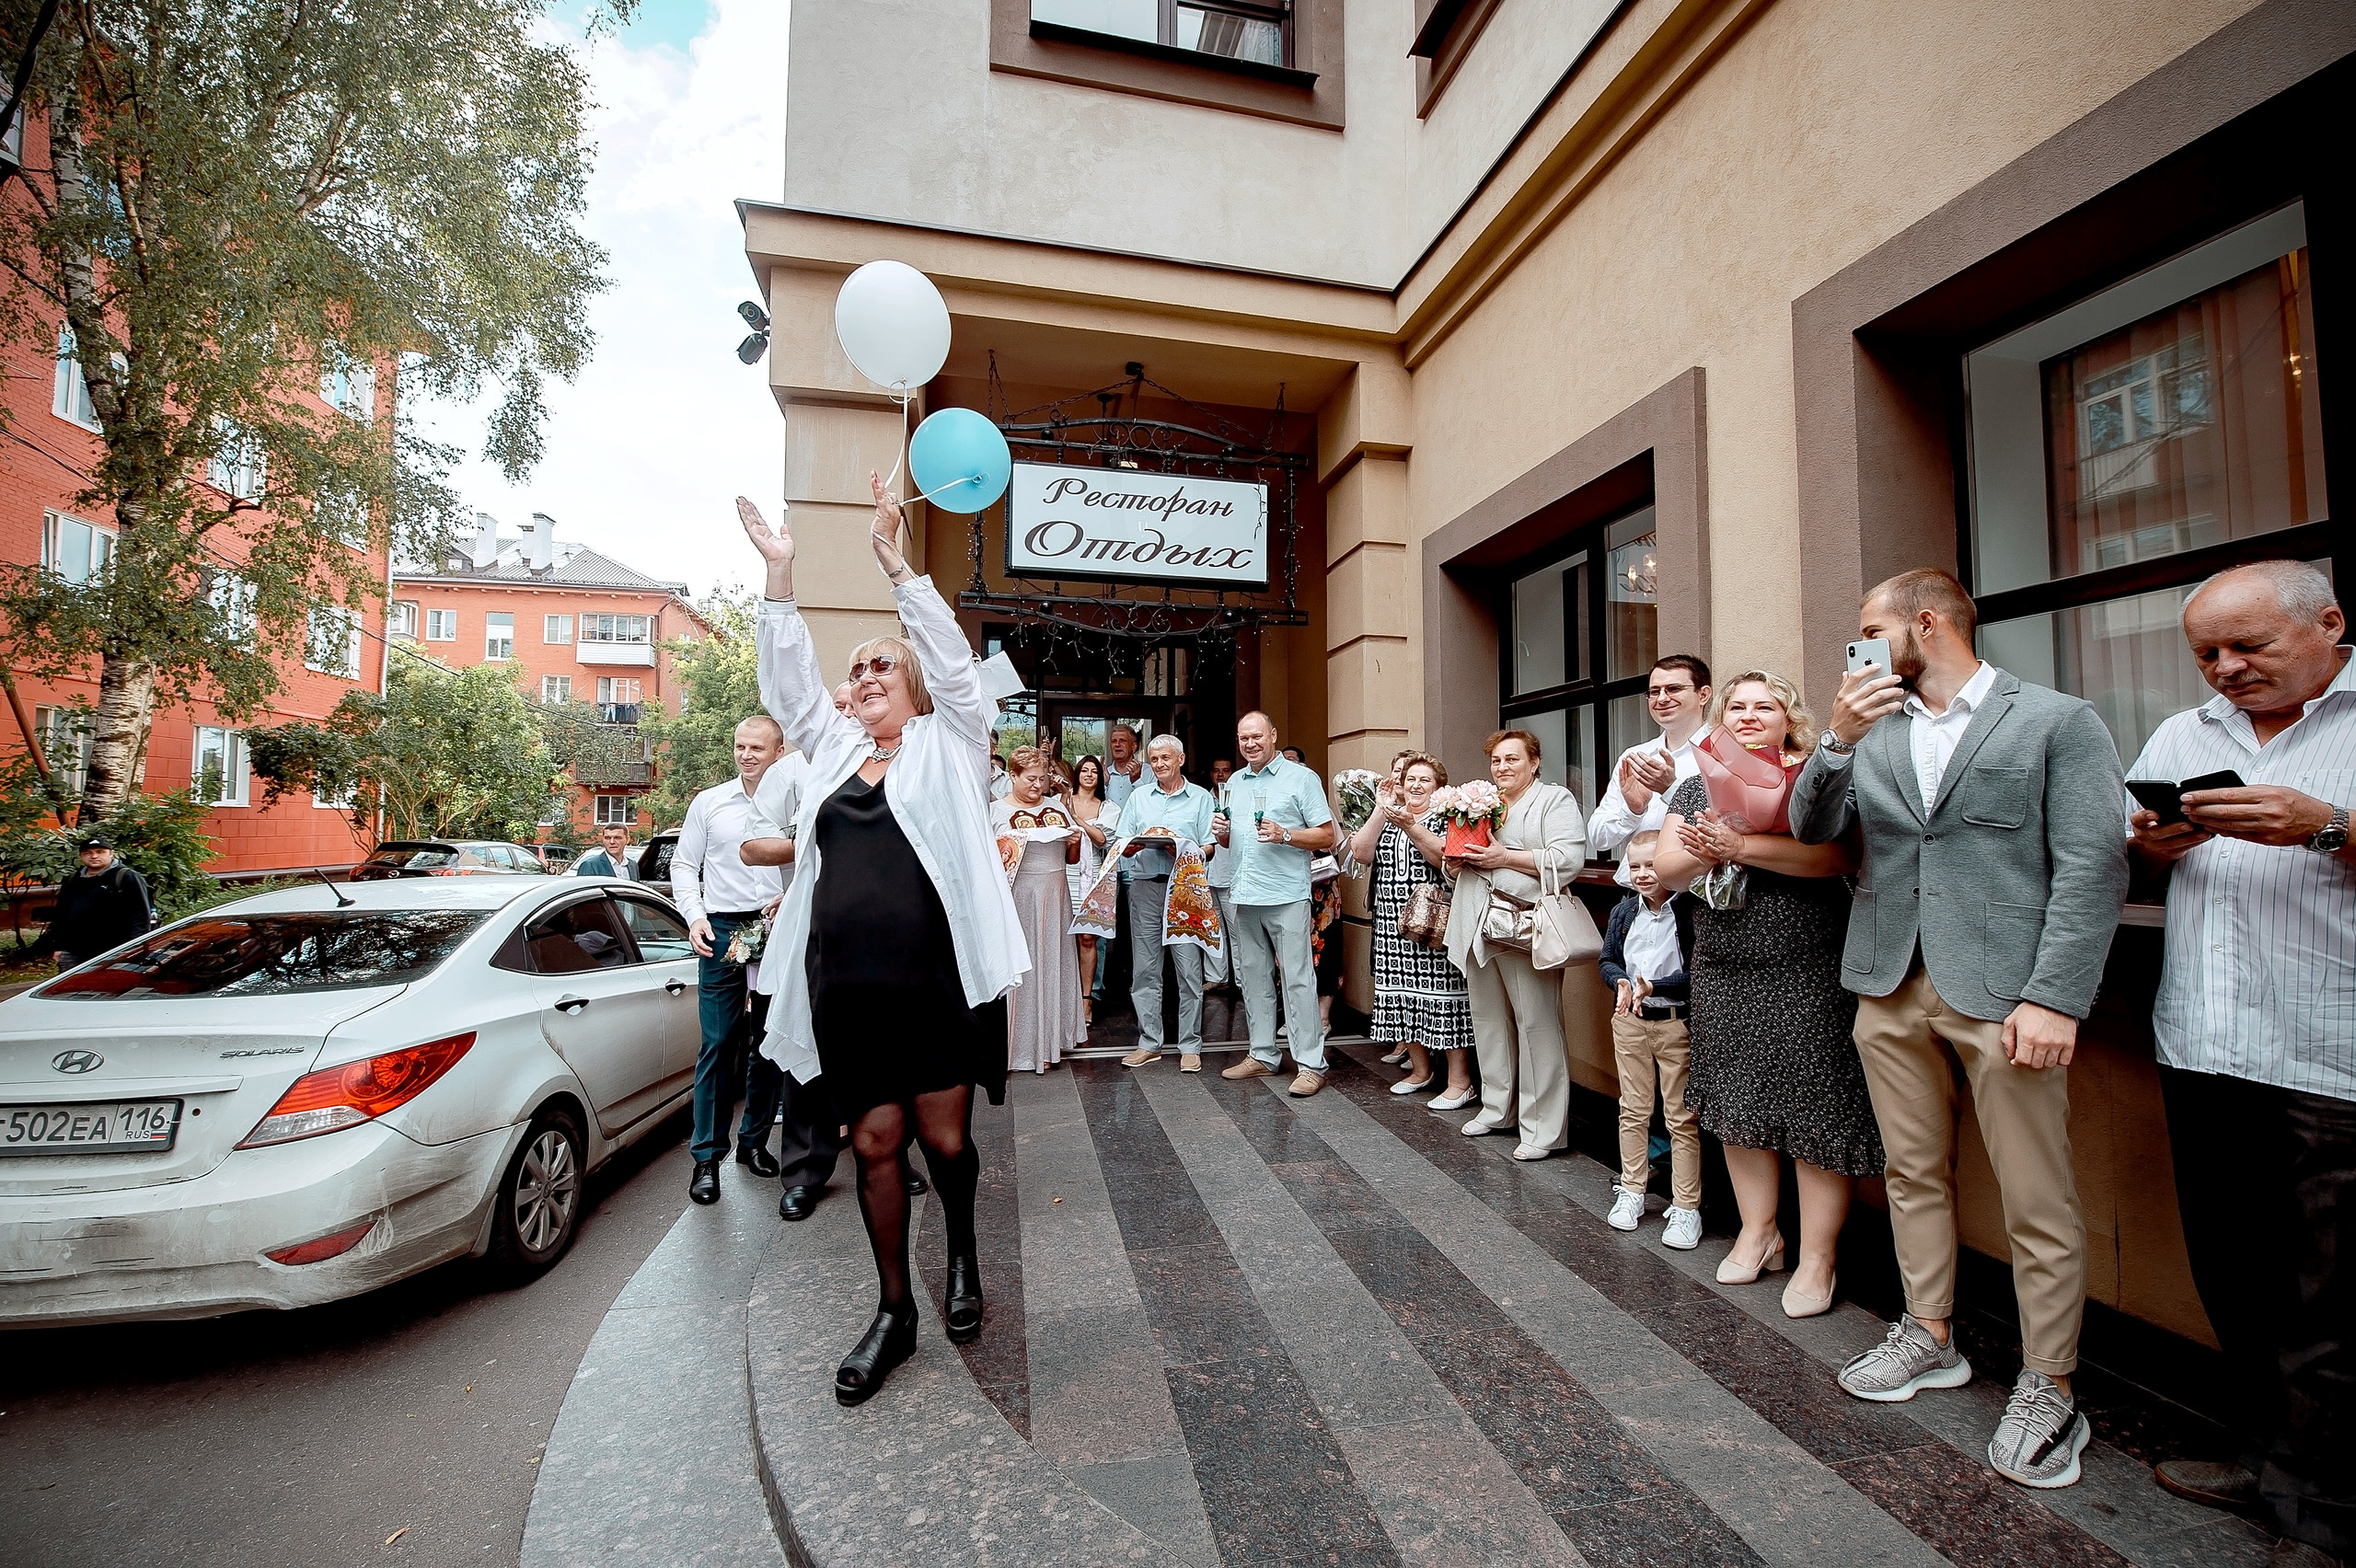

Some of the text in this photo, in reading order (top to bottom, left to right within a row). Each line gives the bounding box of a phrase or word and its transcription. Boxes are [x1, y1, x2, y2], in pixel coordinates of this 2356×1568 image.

[1043, 478, 1234, 522] Ресторан
[1024, 520, 1254, 570] Отдых
[220, 1045, 306, 1059] SOLARIS
[0, 1107, 166, 1143] 502EA 116
[125, 1130, 150, 1139] RUS
